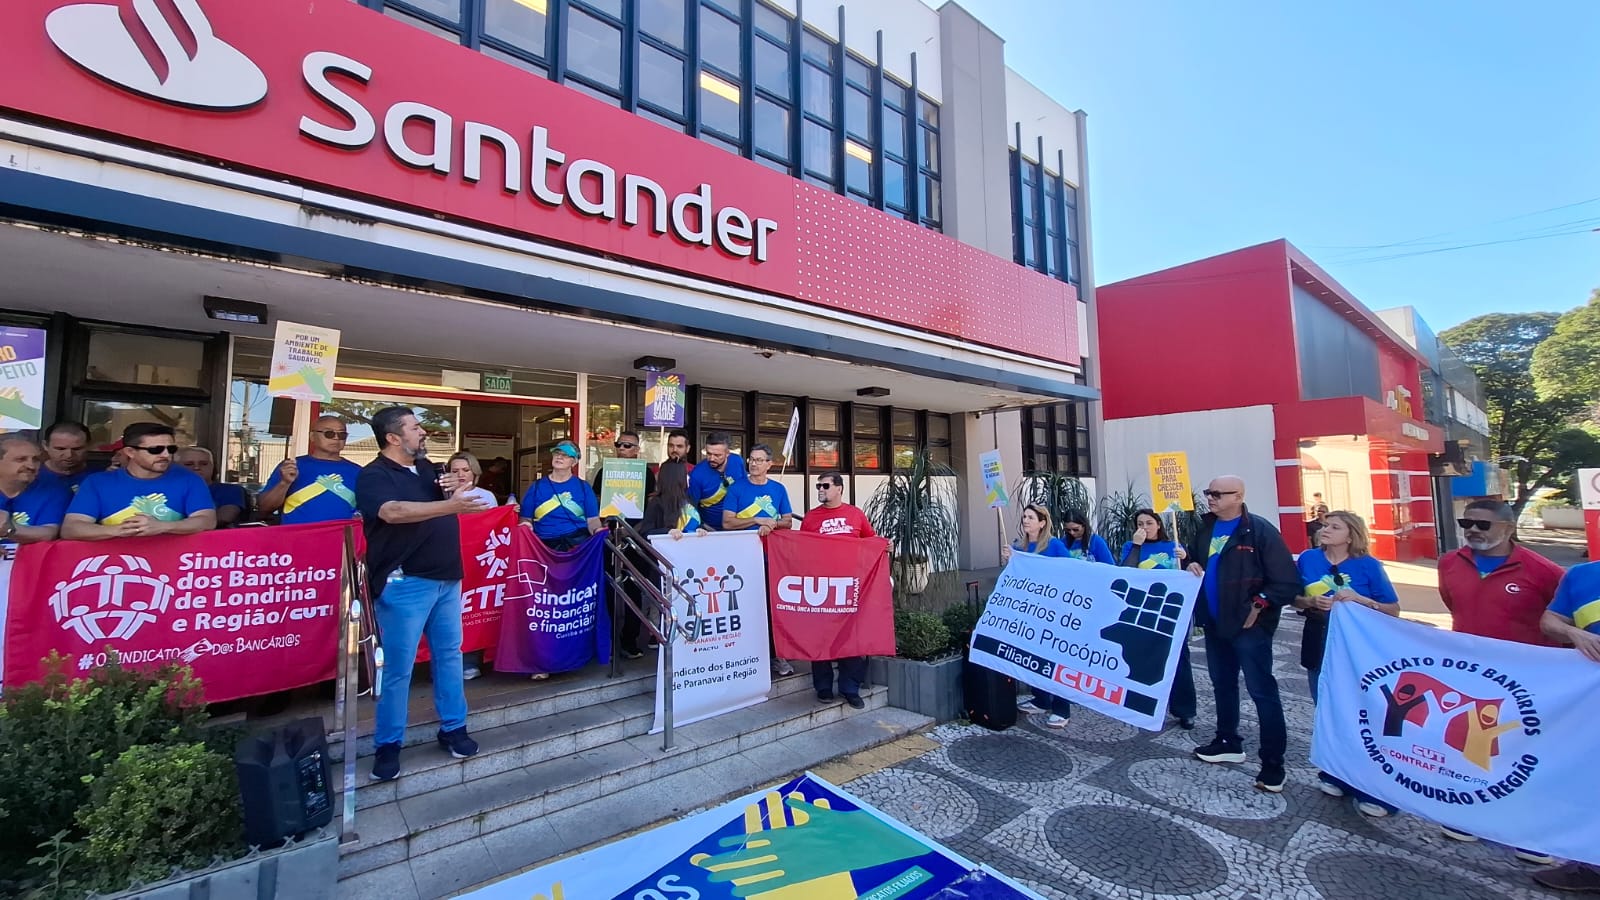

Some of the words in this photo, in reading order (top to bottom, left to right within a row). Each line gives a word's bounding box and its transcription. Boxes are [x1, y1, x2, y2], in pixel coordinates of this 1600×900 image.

[299, 51, 777, 262] Santander
[285, 339, 319, 349] AMBIENTE
[288, 353, 320, 364] SAUDÁVEL
[289, 347, 323, 357] TRABALHO
[486, 377, 511, 390] SAÍDA
[655, 385, 677, 394] MENOS
[655, 393, 676, 402] METAS
[654, 401, 676, 412] MAIS
[1159, 458, 1176, 466] JUROS
[606, 470, 625, 479] LUTAR
[626, 471, 642, 480] PARA
[1155, 466, 1182, 475] MENORES
[1161, 475, 1177, 483] PARA
[1157, 482, 1184, 492] CRESCER
[1164, 491, 1179, 499] MAIS
[822, 517, 846, 527] CUT
[178, 551, 293, 571] Sindicato
[177, 572, 222, 590] dos
[229, 566, 336, 588] Bancários
[175, 592, 207, 610] de
[214, 586, 317, 608] Londrina
[534, 581, 598, 605] sindicat
[777, 575, 853, 606] CUT
[1001, 574, 1058, 599] Sindicato
[1062, 589, 1093, 610] dos
[460, 583, 506, 614] ETE
[527, 604, 550, 619] dos
[776, 604, 796, 612] CENTRAL
[989, 592, 1056, 623] Bancários
[1060, 612, 1082, 631] de
[172, 618, 188, 632] e
[529, 622, 538, 631] e
[684, 615, 741, 637] SEEB
[981, 610, 1035, 641] Cornélio
[1039, 628, 1119, 671] Procópio
[674, 666, 705, 677] ndicato
[708, 663, 723, 672] dos
[725, 655, 759, 669] Bancários
[996, 643, 1039, 671] Filiado
[1041, 662, 1052, 676] à
[1060, 667, 1118, 701] CUT
[733, 668, 757, 680] Região
[1360, 657, 1435, 692] SINDICATO
[1441, 658, 1480, 673] DOS
[1481, 668, 1541, 736] BANCÁRIOS
[1359, 709, 1369, 725] DE
[1360, 728, 1394, 775] CAMPO
[1389, 749, 1436, 771] CONTRAF
[1487, 754, 1539, 800] REGIÃO
[1394, 771, 1475, 805] MOURÃO
[1475, 789, 1491, 803] E
[892, 870, 924, 891] FILIADOS
